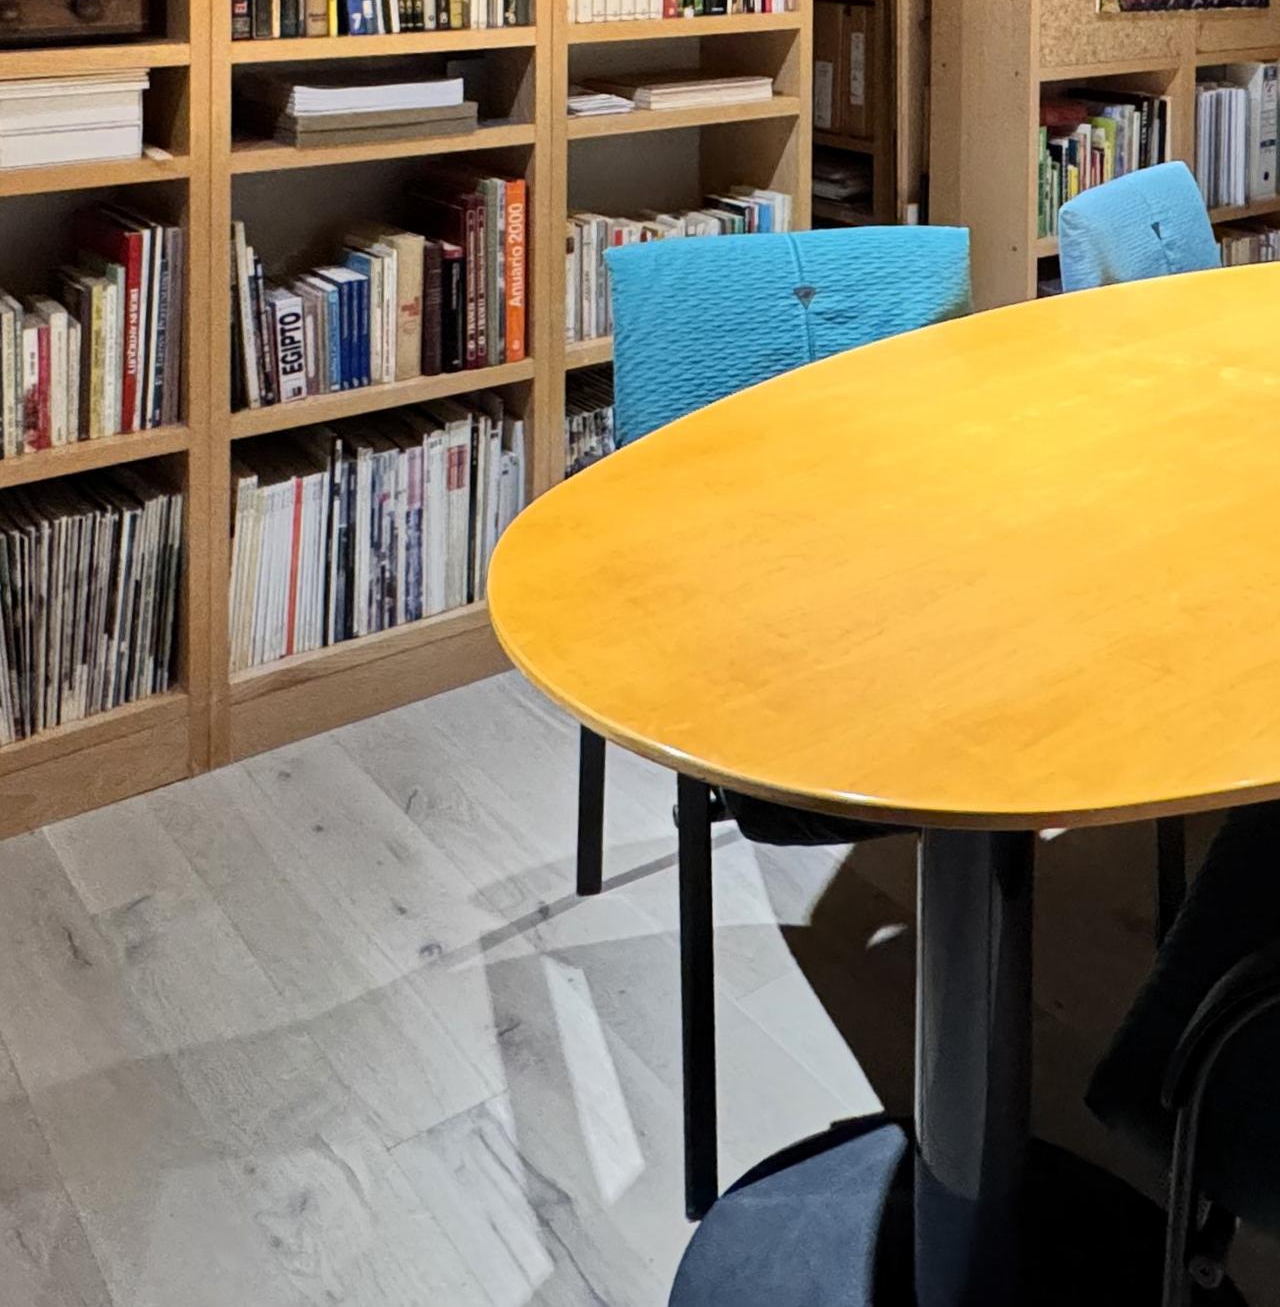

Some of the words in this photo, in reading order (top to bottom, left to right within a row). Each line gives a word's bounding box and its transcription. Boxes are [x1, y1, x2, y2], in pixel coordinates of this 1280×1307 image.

[235, 1, 247, 14] EL
[509, 202, 523, 244] 2000
[510, 246, 523, 307] Anuario
[279, 313, 303, 375] EGIPTO
